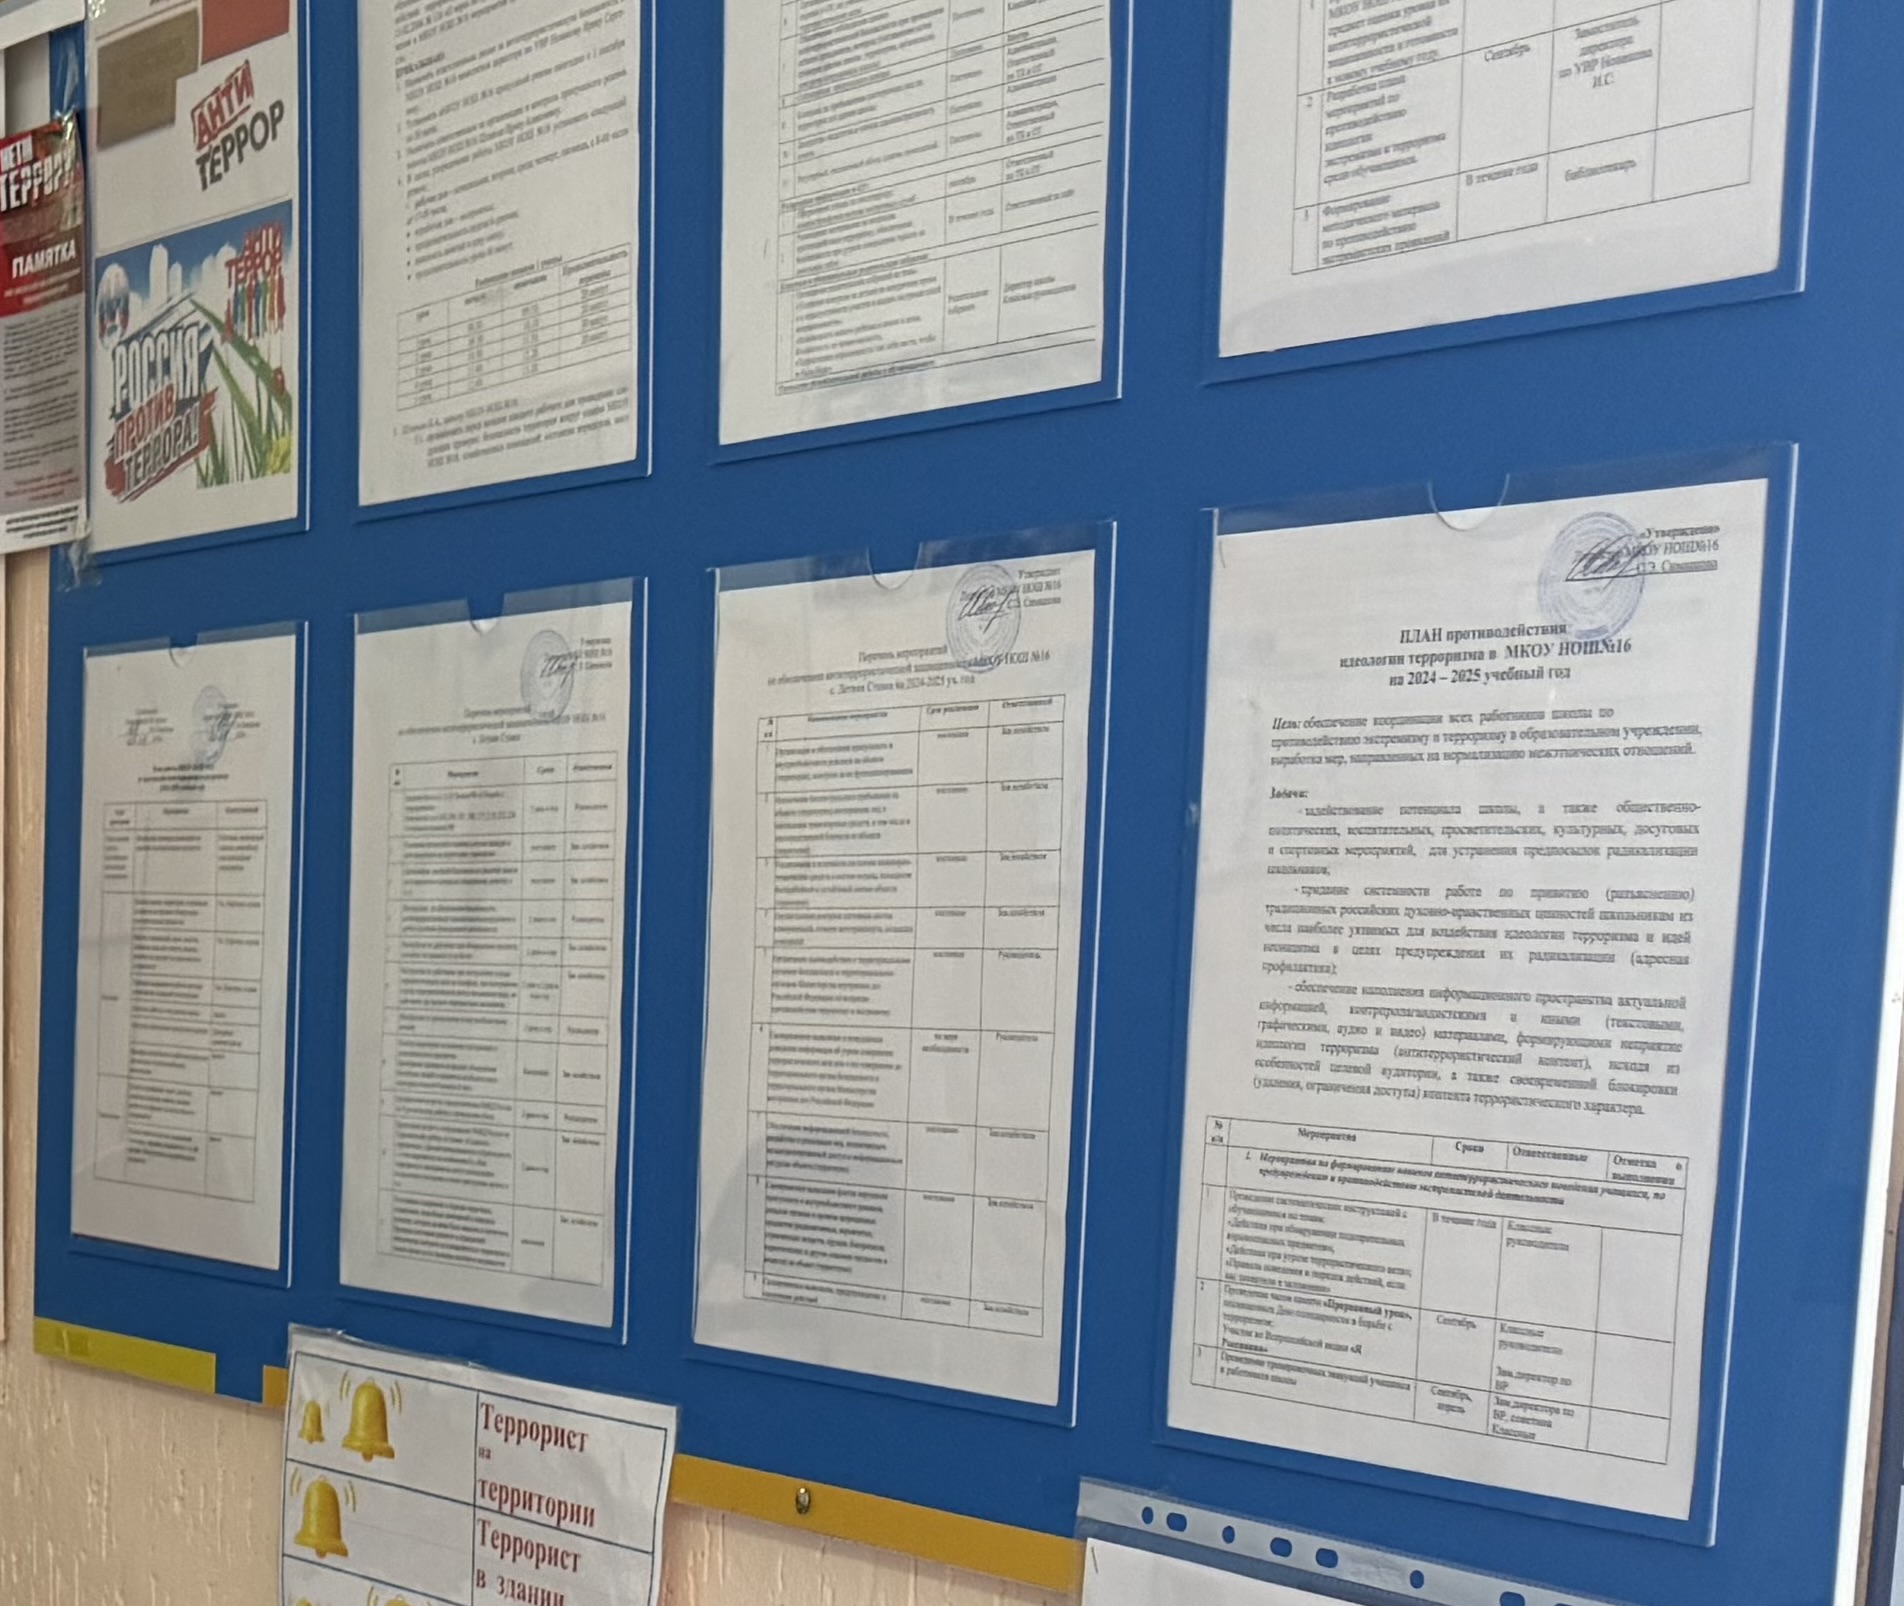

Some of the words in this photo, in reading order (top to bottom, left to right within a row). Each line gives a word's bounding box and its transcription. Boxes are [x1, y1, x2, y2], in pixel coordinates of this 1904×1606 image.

[193, 61, 254, 152] АНТИ
[195, 99, 284, 191] ТЕРРОР
[12, 239, 77, 279] ПАМЯТКА
[112, 322, 202, 415] РОССИЯ
[114, 383, 175, 460] ПРОТИВ
[124, 402, 201, 495] ТЕРРОРА!
[1400, 628, 1443, 644] ПЛАН
[1446, 624, 1566, 642] противодействия
[1408, 651, 1487, 668] терроризма
[1504, 643, 1554, 658] МКОУ
[1389, 677, 1403, 686] на
[1408, 670, 1437, 685] 2024
[1451, 669, 1480, 683] 2025
[1483, 666, 1544, 685] учебный
[1549, 666, 1571, 679] год
[478, 1446, 491, 1461] на
[480, 1401, 589, 1454] Террорист
[478, 1476, 595, 1528] территории
[477, 1516, 581, 1573] Террорист
[476, 1570, 486, 1590] в
